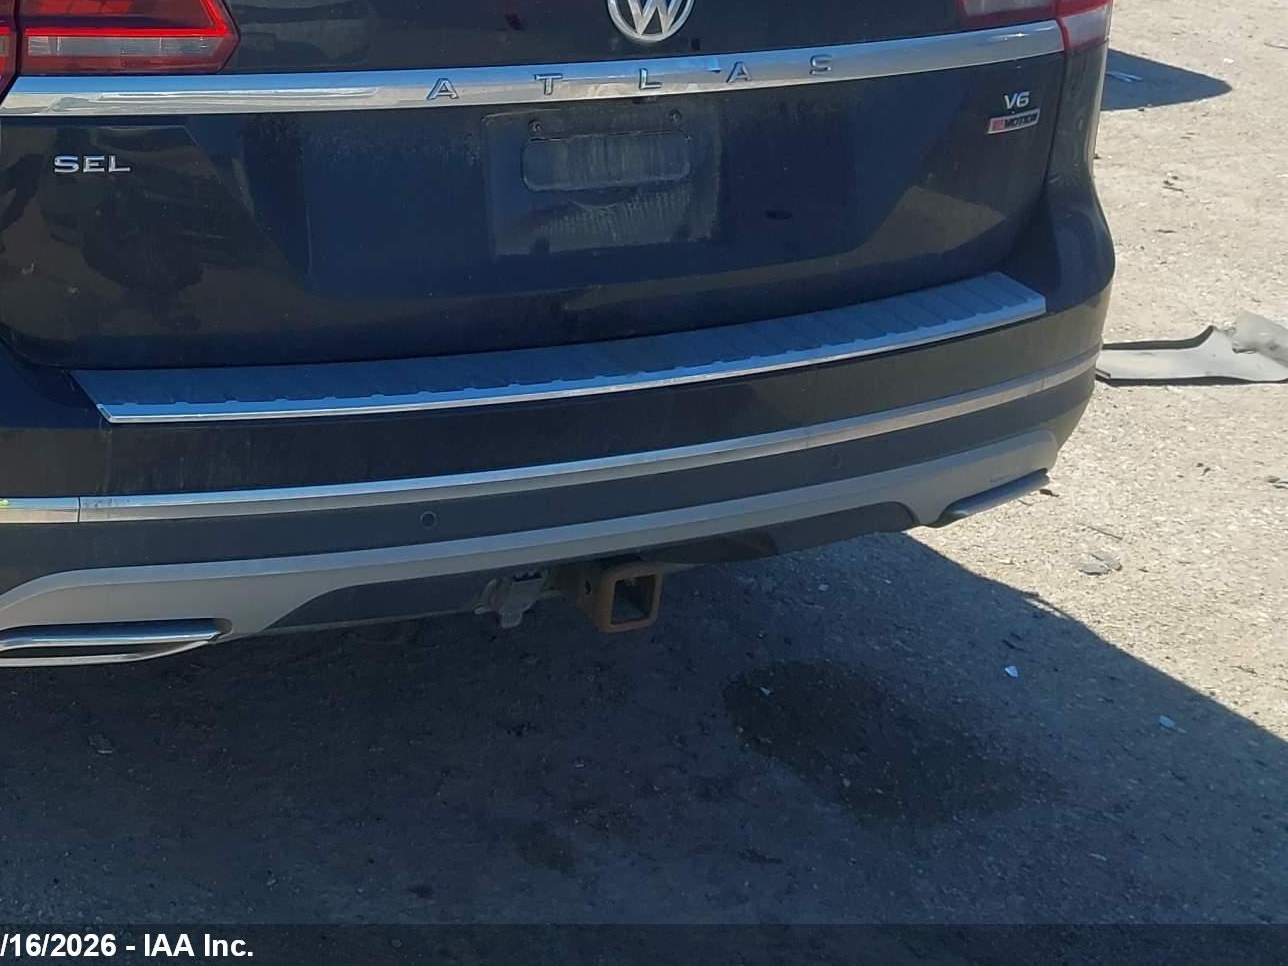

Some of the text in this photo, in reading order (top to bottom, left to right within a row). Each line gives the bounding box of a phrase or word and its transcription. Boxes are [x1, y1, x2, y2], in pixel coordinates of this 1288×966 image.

[425, 53, 833, 102] ATLAS
[1003, 90, 1031, 110] V6
[53, 154, 132, 173] SEL
